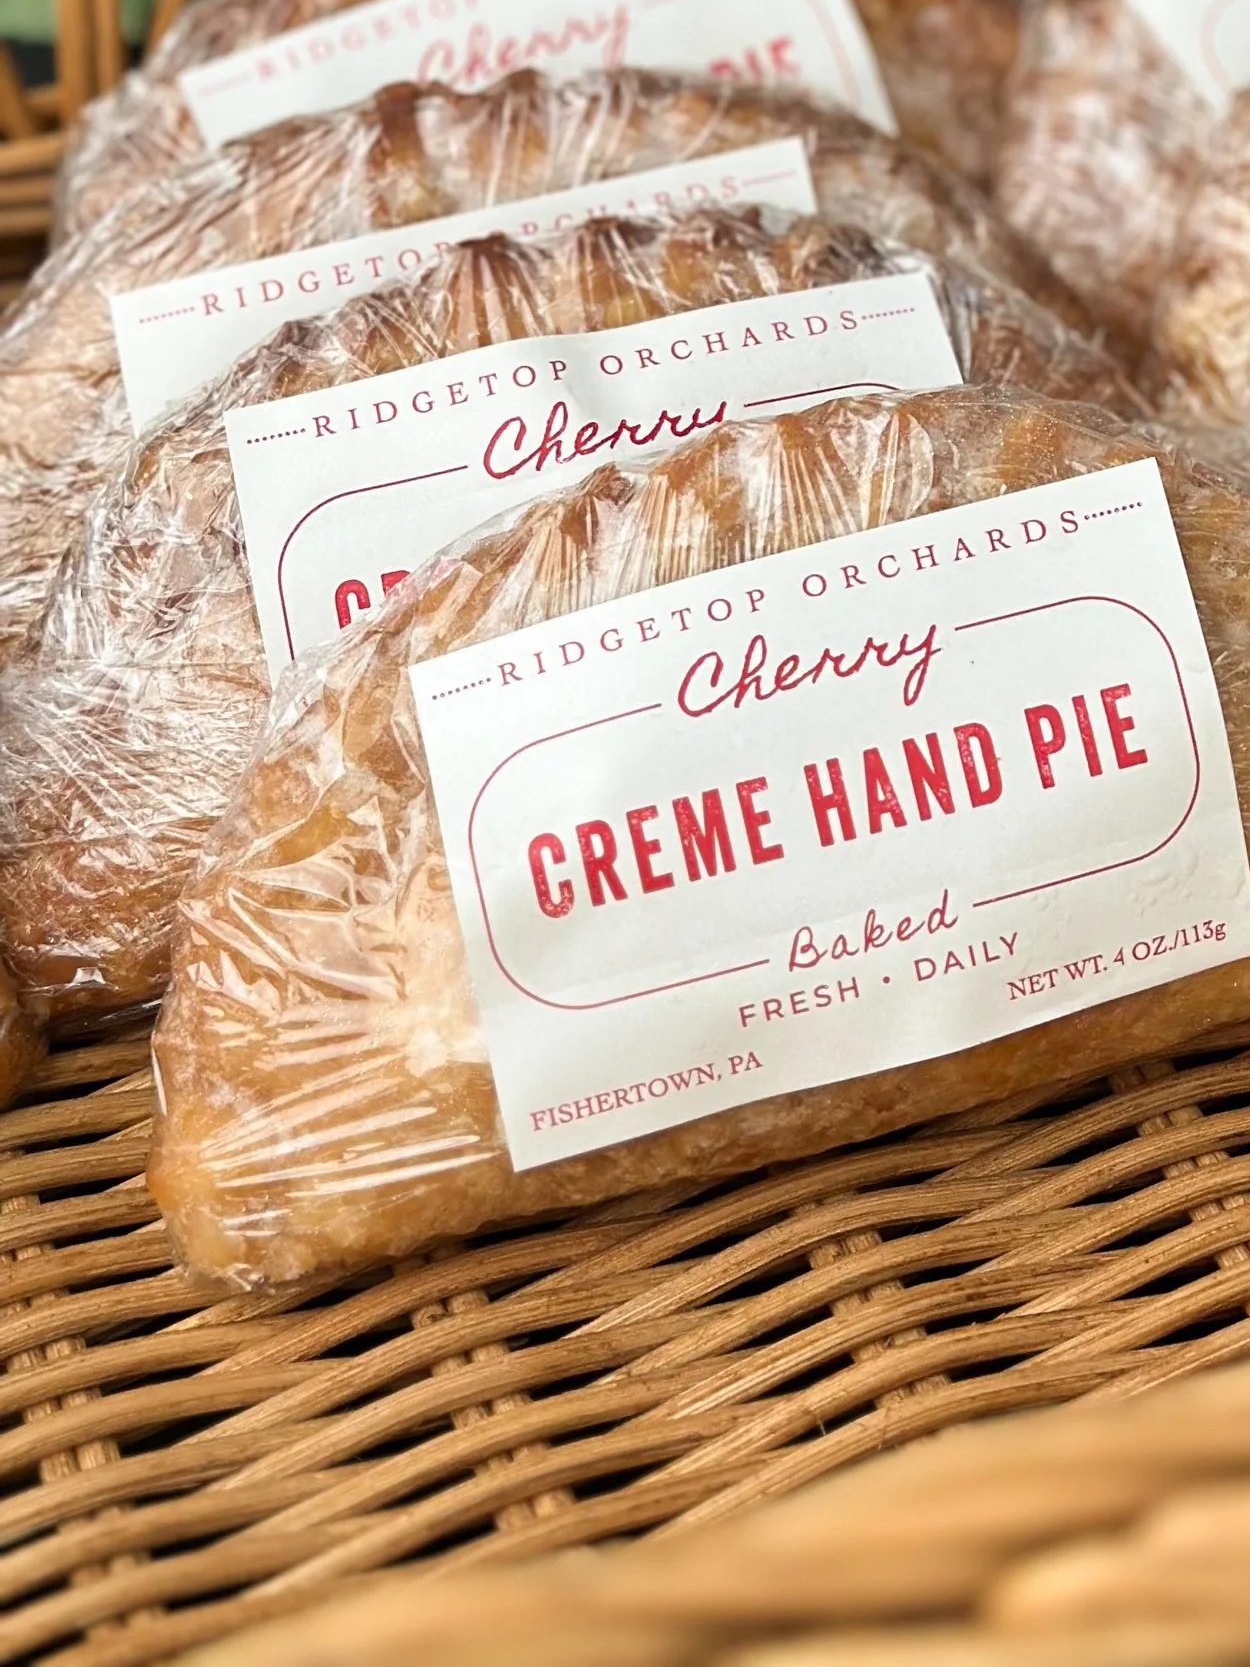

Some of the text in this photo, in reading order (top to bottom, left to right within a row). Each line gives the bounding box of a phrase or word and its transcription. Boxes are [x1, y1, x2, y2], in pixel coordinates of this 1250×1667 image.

[312, 309, 859, 438] RIDGETOP ORCHARDS
[498, 589, 767, 686] RIDGETOP
[801, 509, 1080, 598] ORCHARDS
[677, 623, 942, 719] Cherry
[527, 683, 1149, 921] CREME HAND PIE
[789, 889, 958, 972] Baked
[1007, 920, 1227, 1001] NET WT. 4 OZ./113g
[737, 931, 1019, 1028] FRESH DAILY
[529, 1050, 764, 1131] FISHERTOWN, PA
